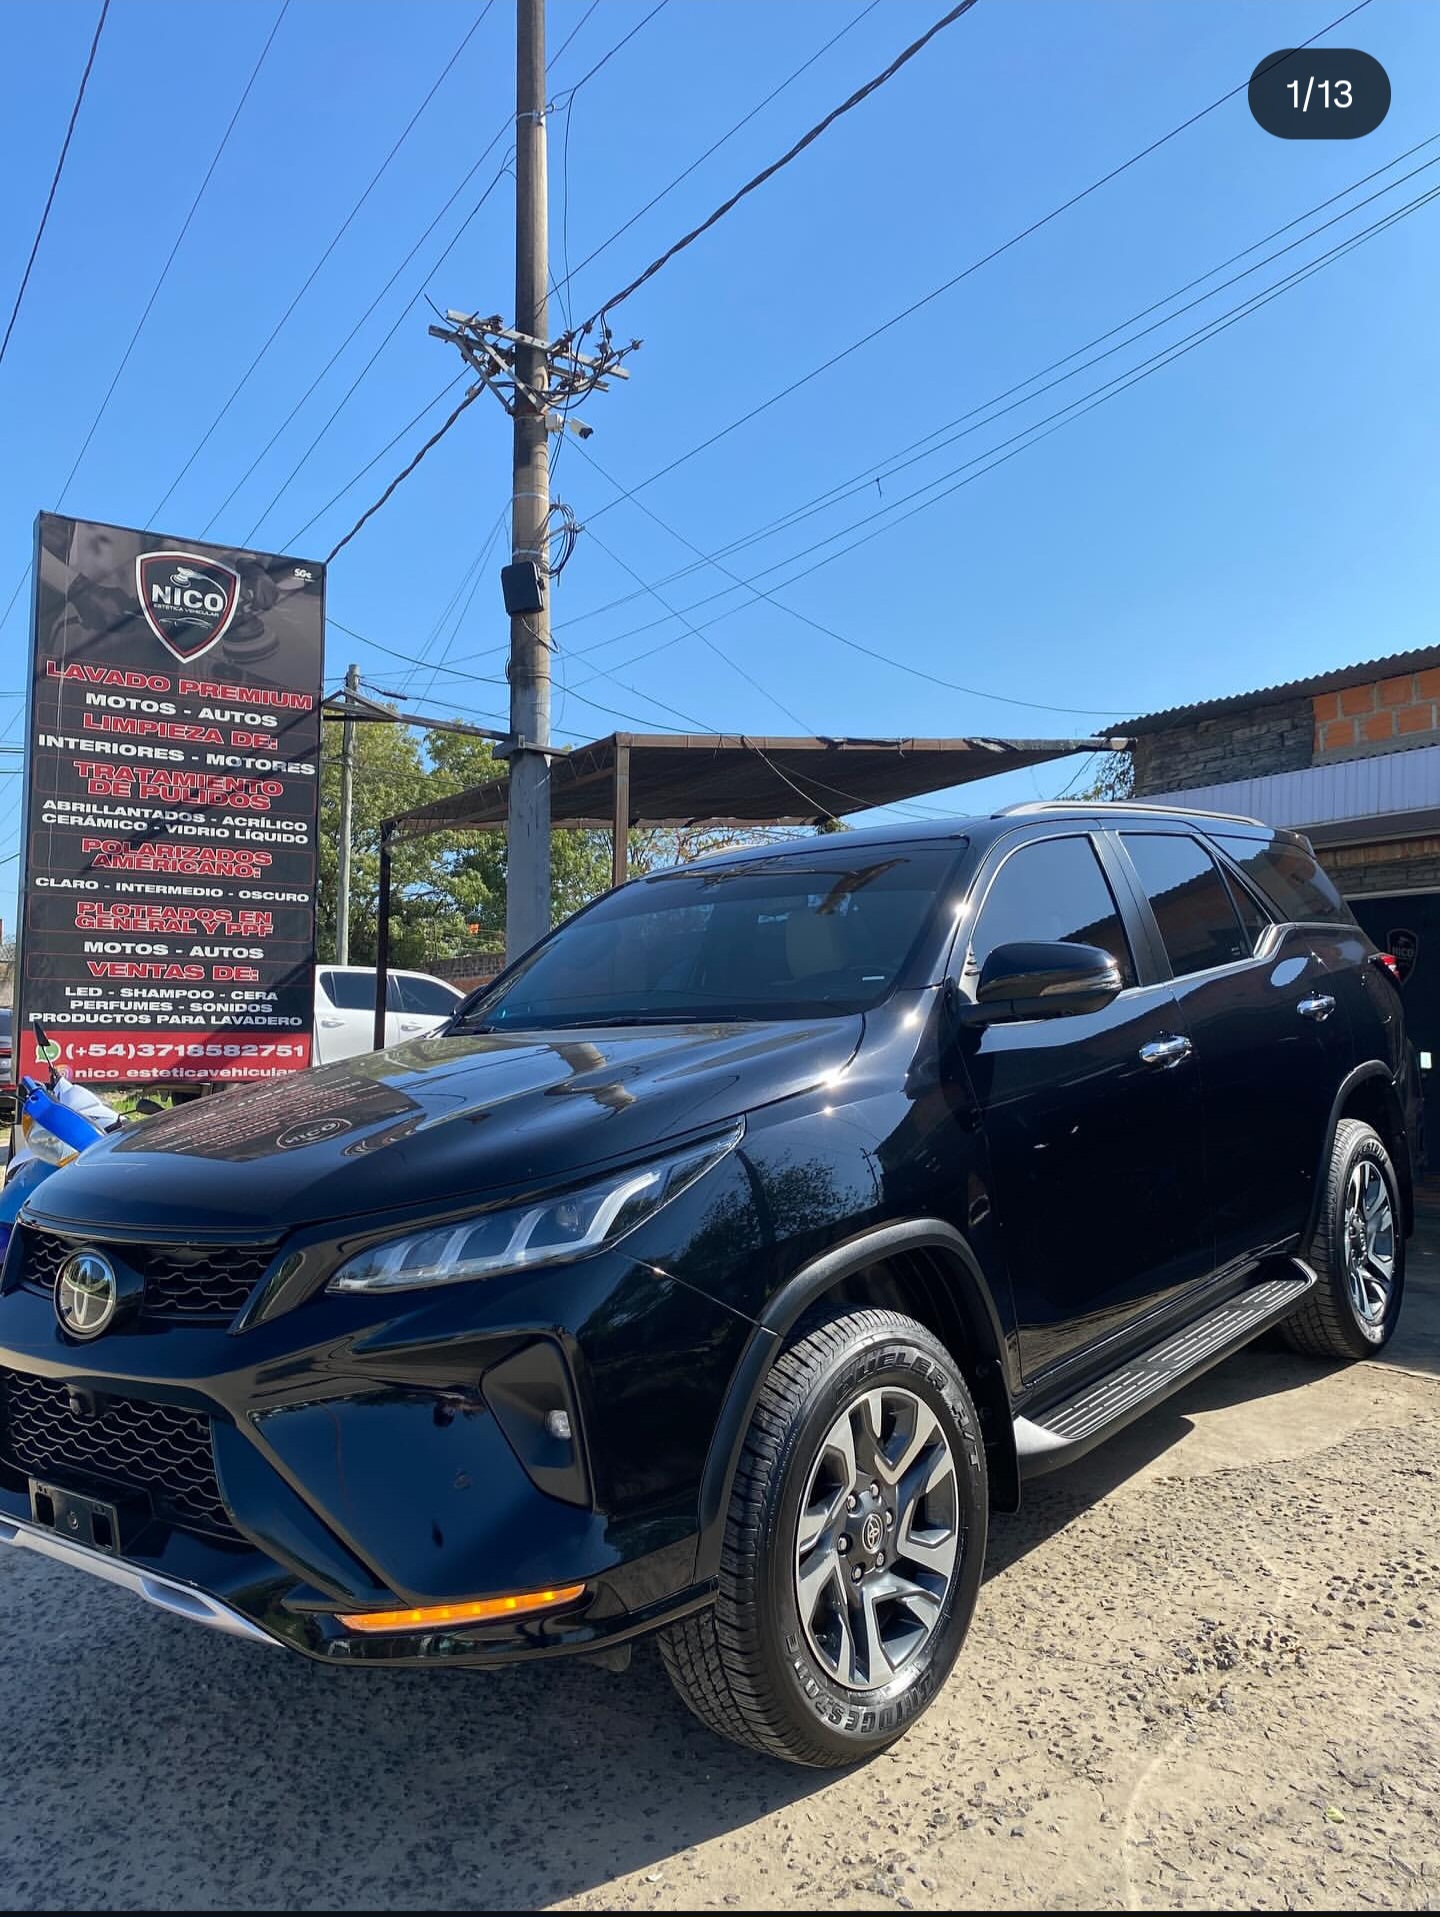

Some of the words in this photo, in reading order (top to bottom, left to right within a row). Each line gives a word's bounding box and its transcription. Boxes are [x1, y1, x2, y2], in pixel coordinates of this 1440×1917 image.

[152, 583, 224, 612] NICO
[47, 661, 170, 692] LAVADO
[179, 679, 312, 710] PREMIUM
[86, 693, 176, 715] MOTOS
[198, 708, 279, 727] AUTOS
[83, 713, 224, 745] LIMPIEZA
[231, 731, 278, 750] DE:
[38, 734, 185, 761] INTERIORES
[206, 753, 315, 775] MOTORES
[73, 761, 283, 796] TRATAMIENTO
[88, 779, 131, 798] DE
[140, 785, 271, 810] PULIDOS
[42, 800, 205, 823] ABRILLANTADOS
[222, 815, 308, 831] ACRÍLICO
[42, 812, 147, 831] CERÁMICO
[166, 824, 230, 838] VIDRIO
[235, 828, 308, 844] LÍQUIDO
[82, 838, 272, 866] POLARIZADOS
[91, 854, 261, 878] AMERICANO:
[35, 877, 98, 890] CLARO
[116, 883, 223, 897] INTERMEDIO
[239, 889, 309, 902] OSCURO
[75, 916, 197, 934] GENERAL
[203, 922, 219, 935] Y
[225, 923, 273, 936] PPF
[77, 902, 232, 923] PLOTEADOS
[239, 911, 272, 924] EN
[84, 941, 169, 956] MOTOS
[189, 945, 264, 959] AUTOS
[87, 961, 205, 980] VENTAS
[213, 965, 259, 982] DE:
[65, 987, 102, 997] LED
[120, 988, 214, 999] SHAMPOO
[231, 990, 279, 1000] CERA
[70, 1000, 173, 1012] PERFUMES
[190, 1002, 272, 1013] SONIDOS
[29, 1013, 151, 1024] PRODUCTOS
[157, 1015, 205, 1025] PARA
[210, 1015, 302, 1026] LAVADERO
[65, 1043, 303, 1060] (+54)3718582751
